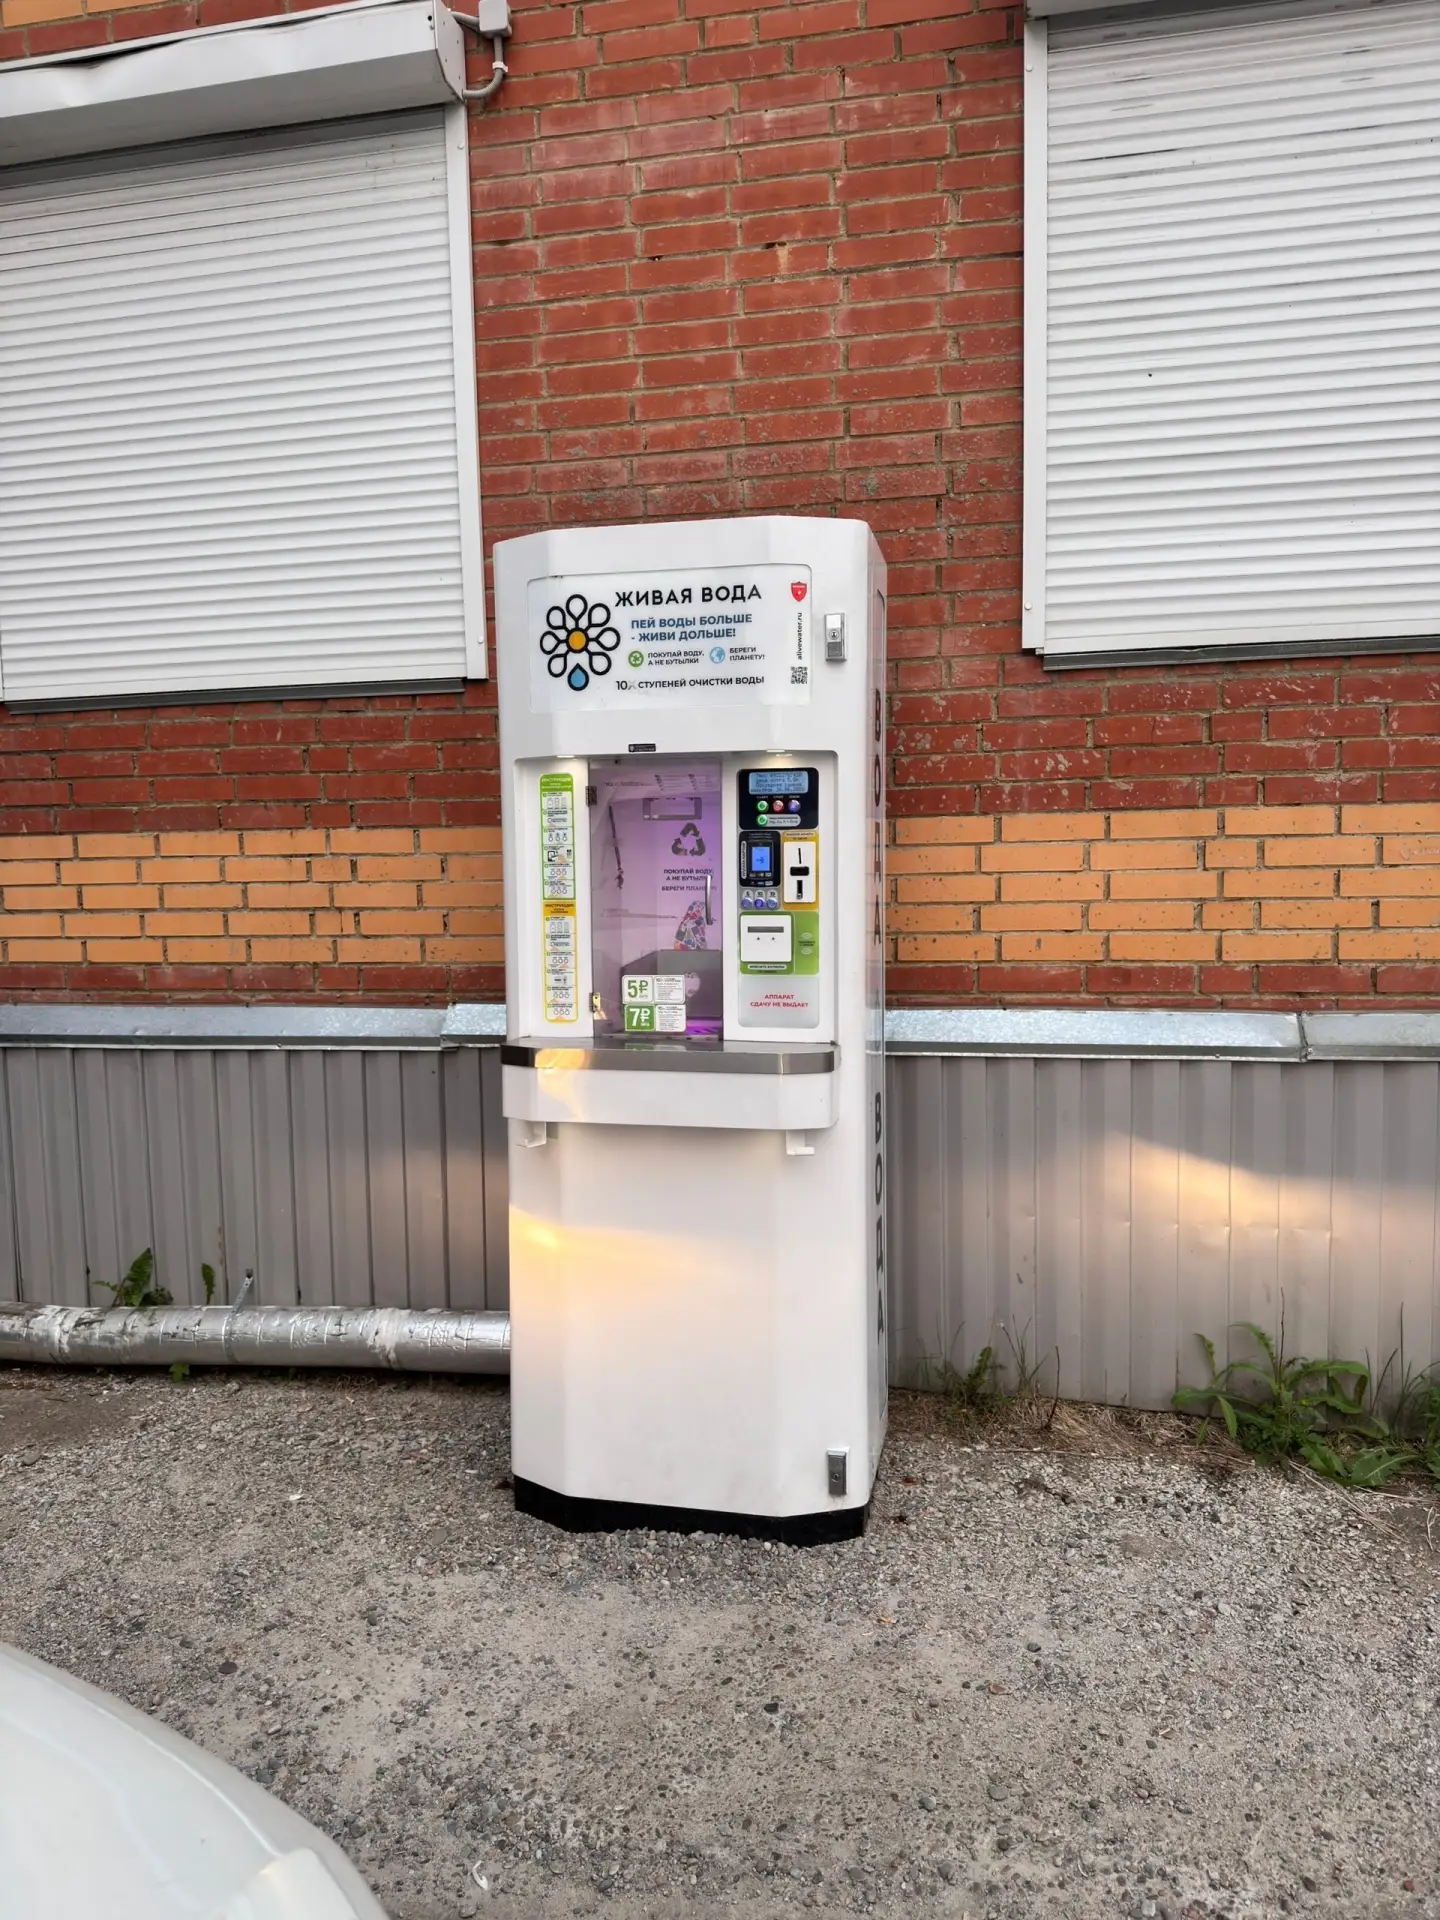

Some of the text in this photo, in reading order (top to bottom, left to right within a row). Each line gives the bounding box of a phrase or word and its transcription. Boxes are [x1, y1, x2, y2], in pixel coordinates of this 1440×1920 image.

[615, 584, 762, 607] ЖИВАЯ ВОДА
[631, 613, 753, 629] ПЕЙ ВОДЫ БОЛЬШЕ
[639, 631, 676, 642] ЖИВИ
[678, 628, 736, 641] ДОЛЬШЕ!
[638, 678, 687, 689] СТУПЕНЕЙ
[689, 677, 734, 687] ОЧИСТКИ
[735, 676, 765, 685] ВОДЫ
